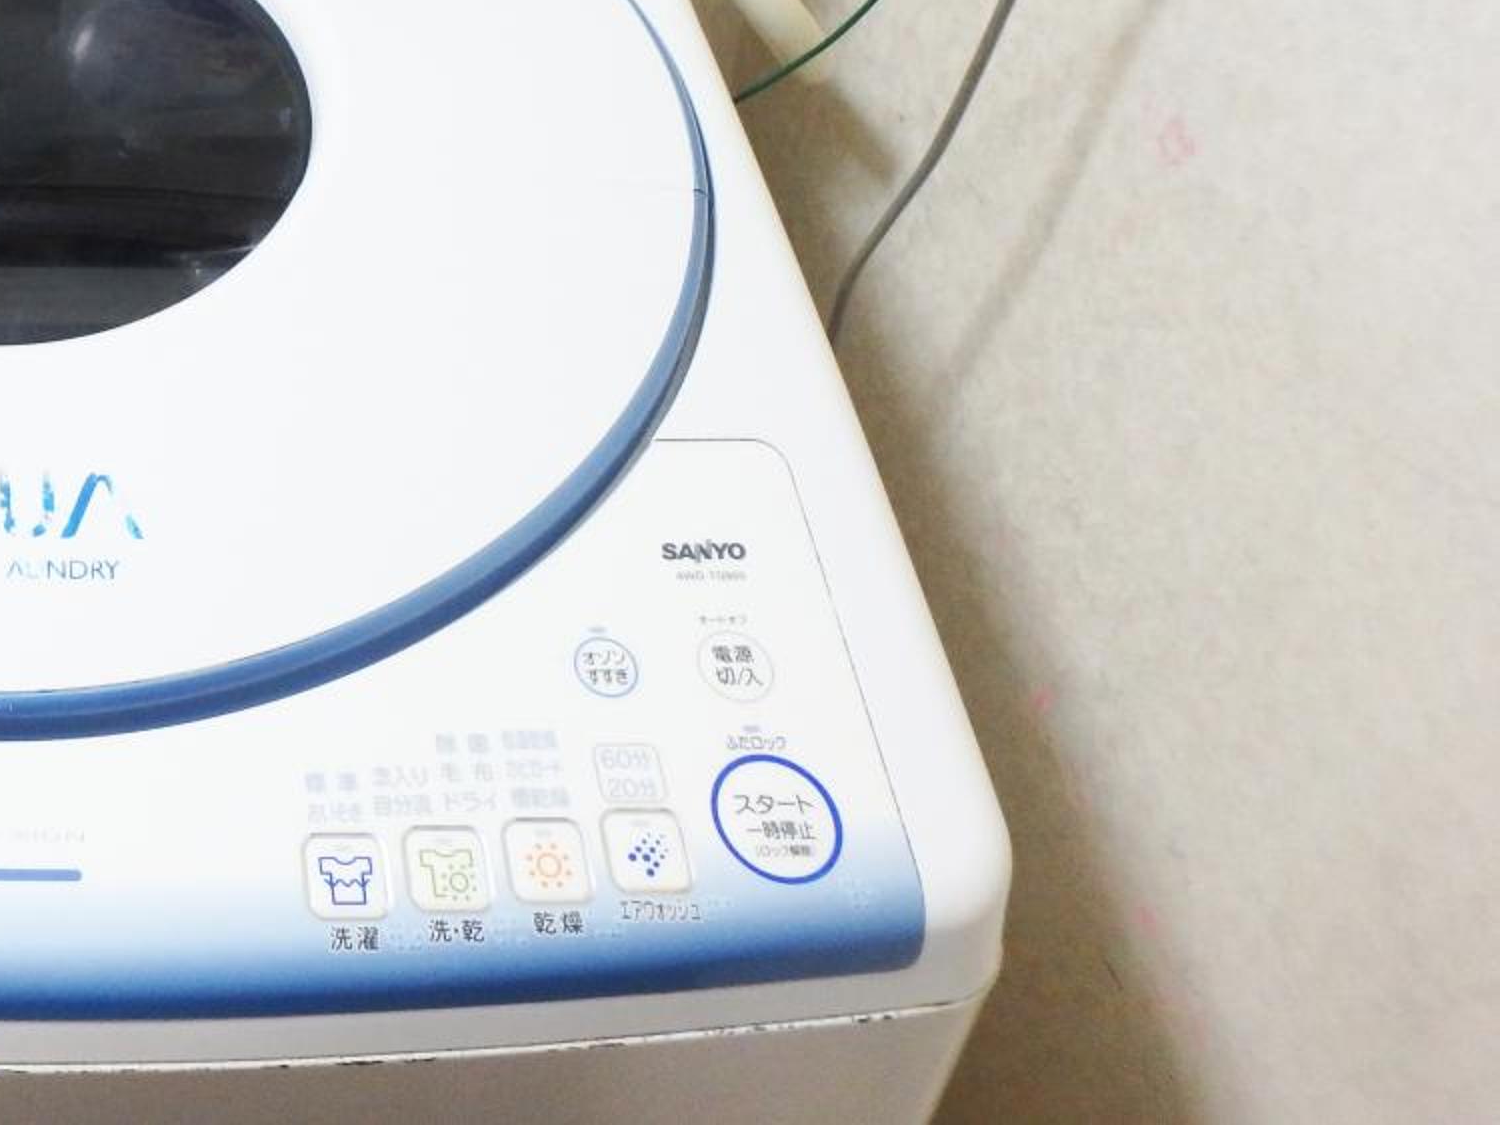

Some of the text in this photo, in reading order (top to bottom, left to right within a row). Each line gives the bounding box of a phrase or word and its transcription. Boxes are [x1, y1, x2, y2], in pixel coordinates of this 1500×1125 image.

[661, 539, 747, 563] SANYO
[711, 645, 755, 664] 電源
[733, 794, 817, 814] スタート
[746, 820, 816, 841] 一時停止
[532, 909, 584, 936] 乾燥
[331, 925, 380, 951] 洗濯
